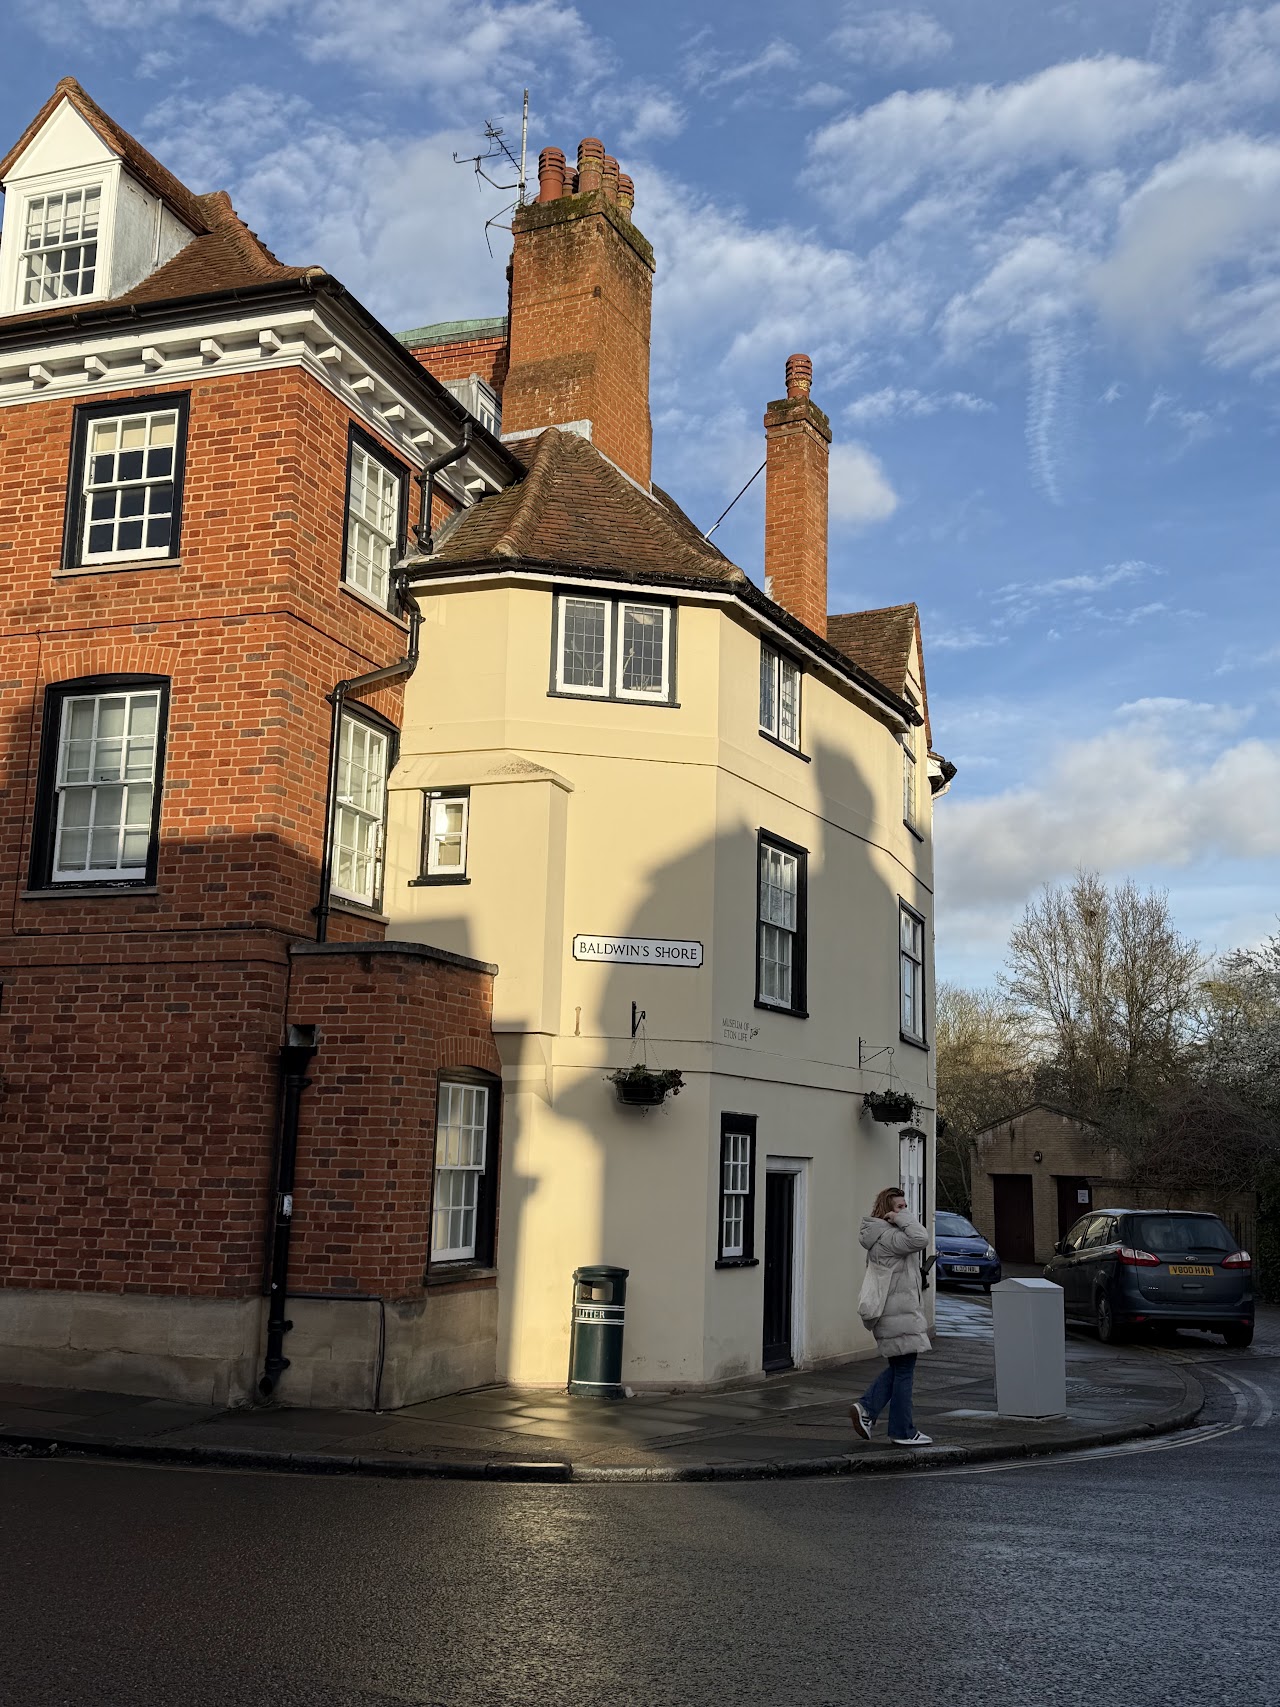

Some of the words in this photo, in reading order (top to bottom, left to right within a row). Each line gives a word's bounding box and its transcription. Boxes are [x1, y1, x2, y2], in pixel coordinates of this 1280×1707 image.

[580, 942, 650, 957] BALDWIN'S
[655, 946, 698, 960] SHORE
[722, 1018, 743, 1030] MUSEUM
[744, 1021, 750, 1031] OF
[724, 1029, 737, 1040] ETON
[738, 1032, 748, 1042] LIFE
[1195, 1266, 1211, 1275] HAN
[578, 1309, 605, 1319] LITTER
